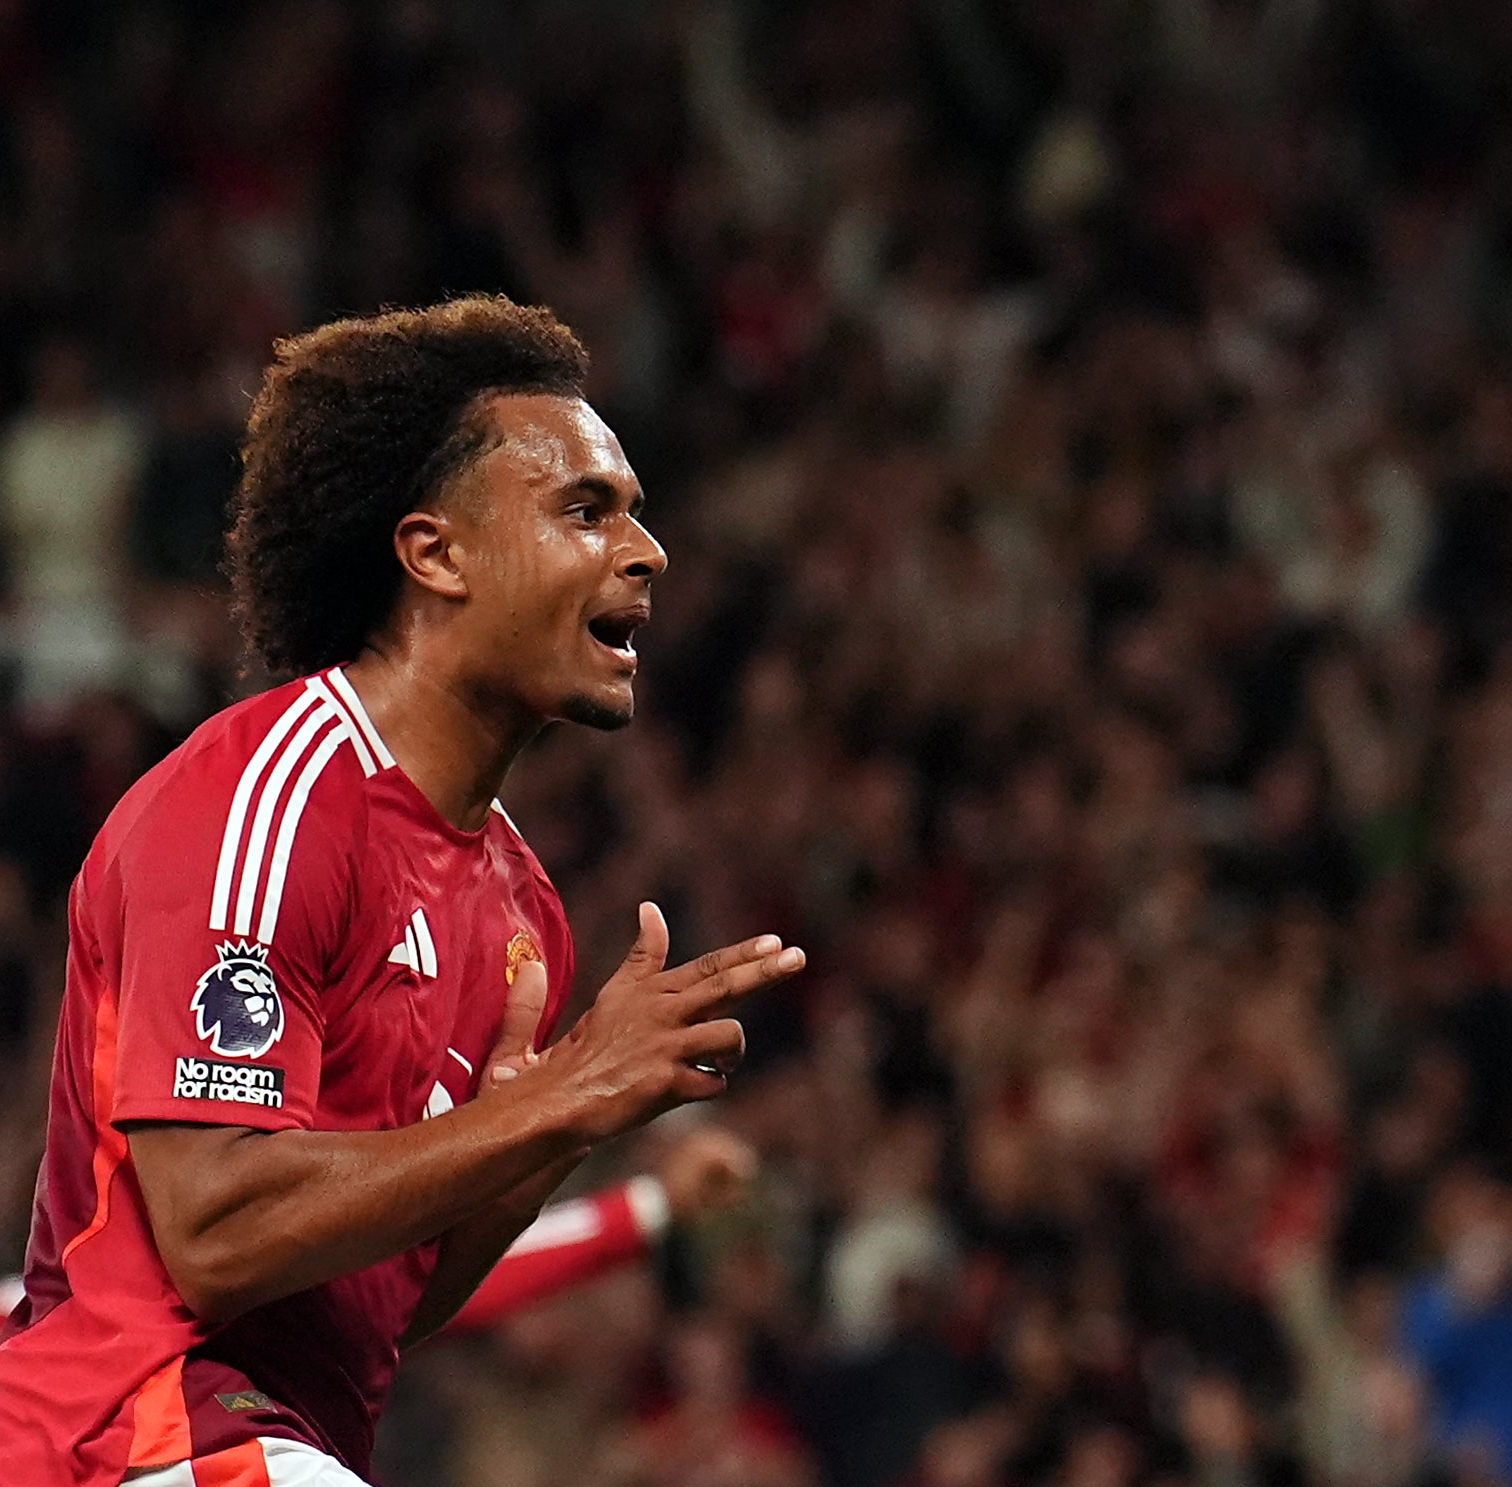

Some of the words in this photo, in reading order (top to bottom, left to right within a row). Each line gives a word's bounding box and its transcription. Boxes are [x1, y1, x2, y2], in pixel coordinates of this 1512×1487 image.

[176, 1057, 209, 1080] No
[212, 1064, 275, 1088] room
[173, 1076, 207, 1098] for
[209, 1082, 283, 1108] racism
